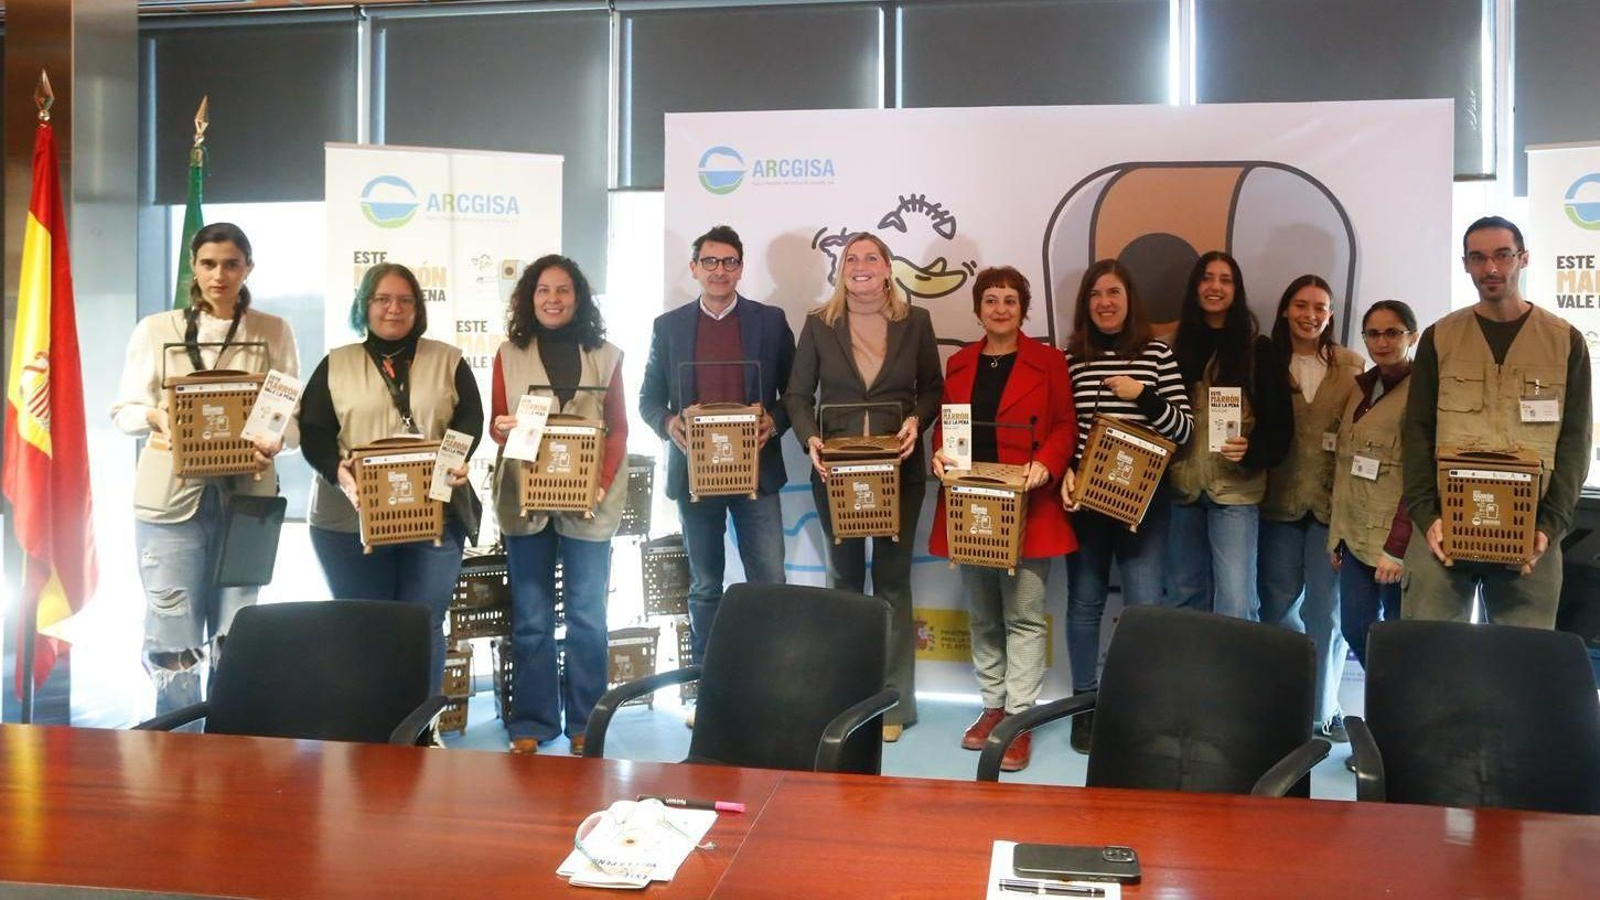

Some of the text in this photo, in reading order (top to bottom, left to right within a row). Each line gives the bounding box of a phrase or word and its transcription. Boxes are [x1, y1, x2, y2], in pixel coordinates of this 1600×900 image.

[752, 159, 835, 178] ARCGISA
[426, 193, 520, 215] ARCGISA
[1556, 255, 1595, 269] ESTE
[1556, 295, 1595, 309] VALE
[456, 320, 488, 333] ESTE
[465, 355, 488, 369] ALE
